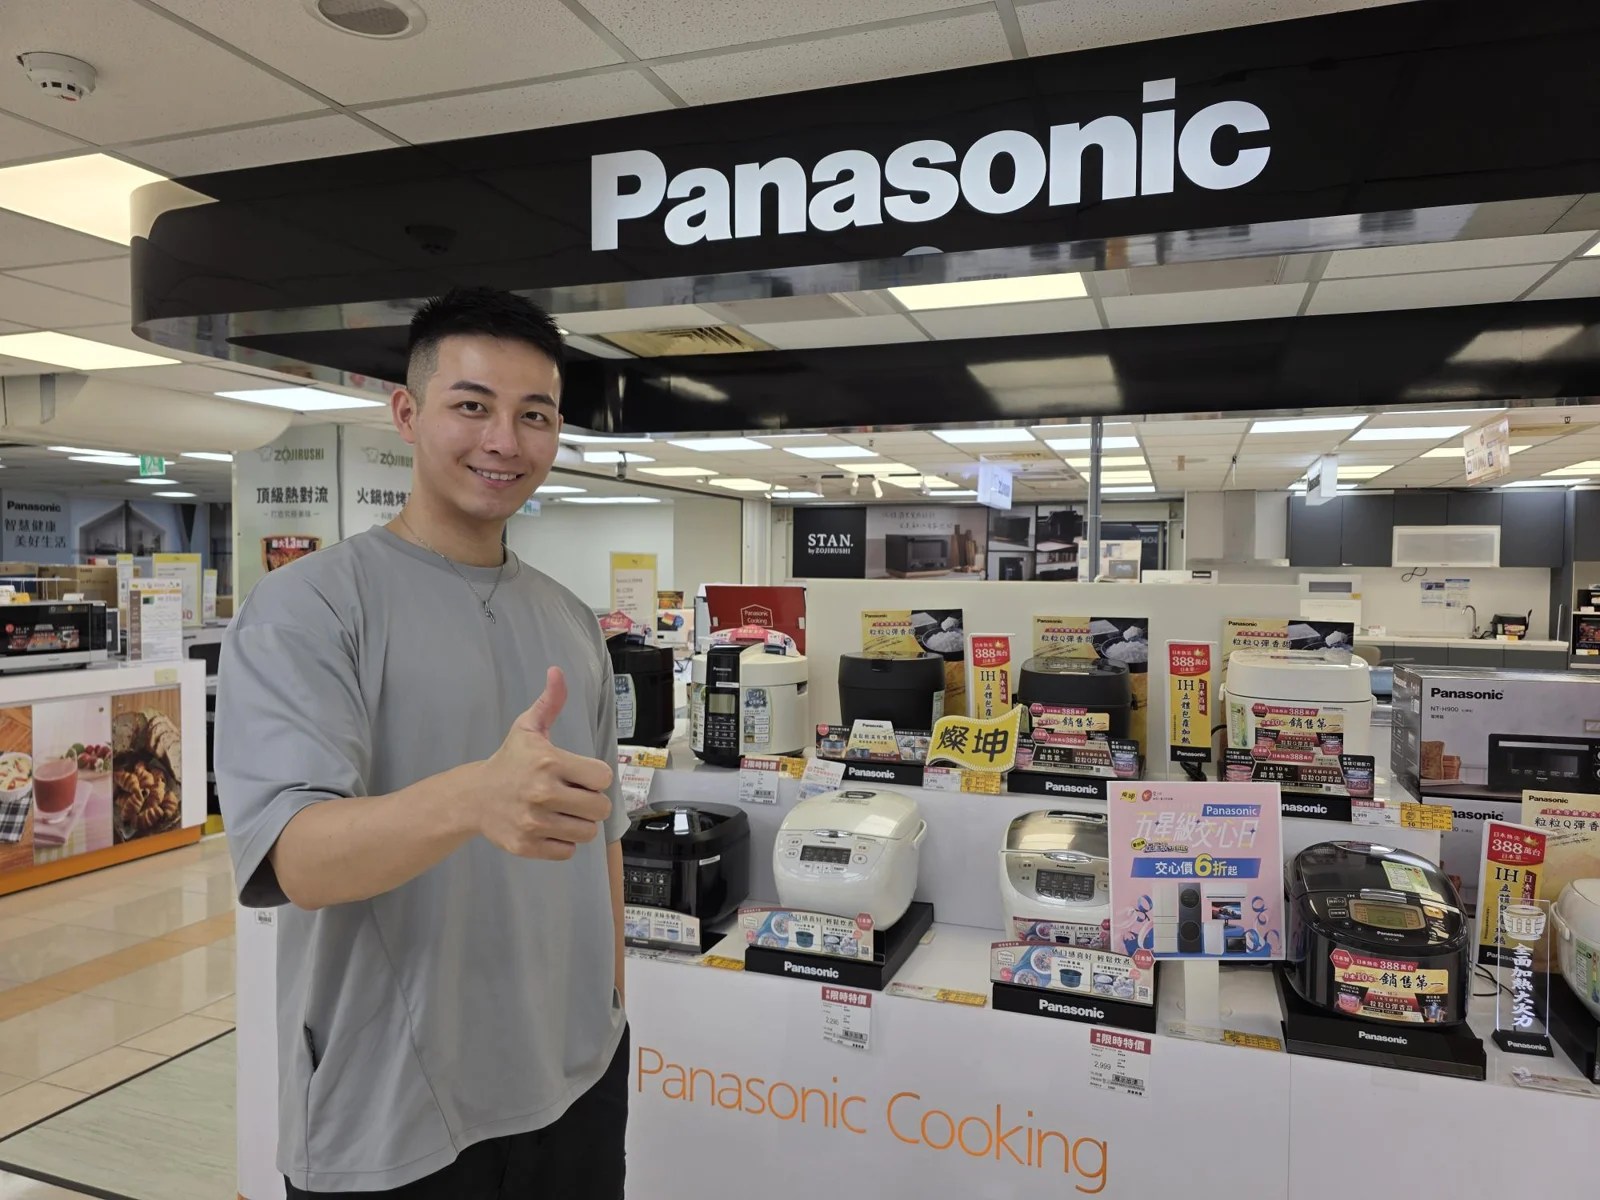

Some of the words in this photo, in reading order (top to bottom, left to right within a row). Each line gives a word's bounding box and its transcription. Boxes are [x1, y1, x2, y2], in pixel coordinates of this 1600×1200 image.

[591, 77, 1270, 250] Panasonic
[256, 486, 329, 504] 頂級熱對流
[356, 487, 412, 508] 火鍋燒烤
[7, 501, 62, 513] Panasonic
[4, 518, 57, 533] 智慧健康
[15, 534, 67, 548] 美好生活
[807, 533, 854, 548] STAN.
[815, 547, 851, 555] ZOJIRUSHI
[1172, 656, 1208, 667] 388萬台
[980, 670, 996, 682] IH
[1177, 679, 1195, 691] IH
[1430, 687, 1504, 700] Panasonic
[1430, 705, 1459, 713] NT-H900
[1062, 717, 1106, 729] 銷售第一
[1288, 717, 1341, 730] 銷售第一
[936, 725, 1009, 763] 燦坤
[848, 767, 895, 779] Panasonic
[1045, 781, 1099, 795] Panasonic
[1528, 795, 1569, 804] Panasonic
[1206, 805, 1257, 816] Panasonic
[1281, 801, 1328, 815] nasonic
[1452, 809, 1504, 822] nasonic
[1135, 811, 1260, 848] 五星級交心日
[1491, 838, 1541, 857] 388萬台
[1154, 853, 1238, 877] 交心價6折起
[1494, 866, 1519, 883] IH
[1511, 918, 1537, 934] IH
[1486, 951, 1515, 962] Panaso
[783, 961, 840, 979] Panasonic
[1379, 972, 1444, 990] 銷售第一
[1511, 943, 1536, 1028] 全面加熱大火力
[830, 990, 868, 1006] 限時特價
[1038, 999, 1105, 1019] Panasonic
[1101, 1033, 1146, 1052] 限時特價
[1358, 1030, 1408, 1045] Panasonic
[1507, 1040, 1547, 1051] Panasonic
[1094, 1060, 1112, 1071] 2,999
[637, 1046, 867, 1134] Panasonic
[886, 1091, 1108, 1194] Cooking
